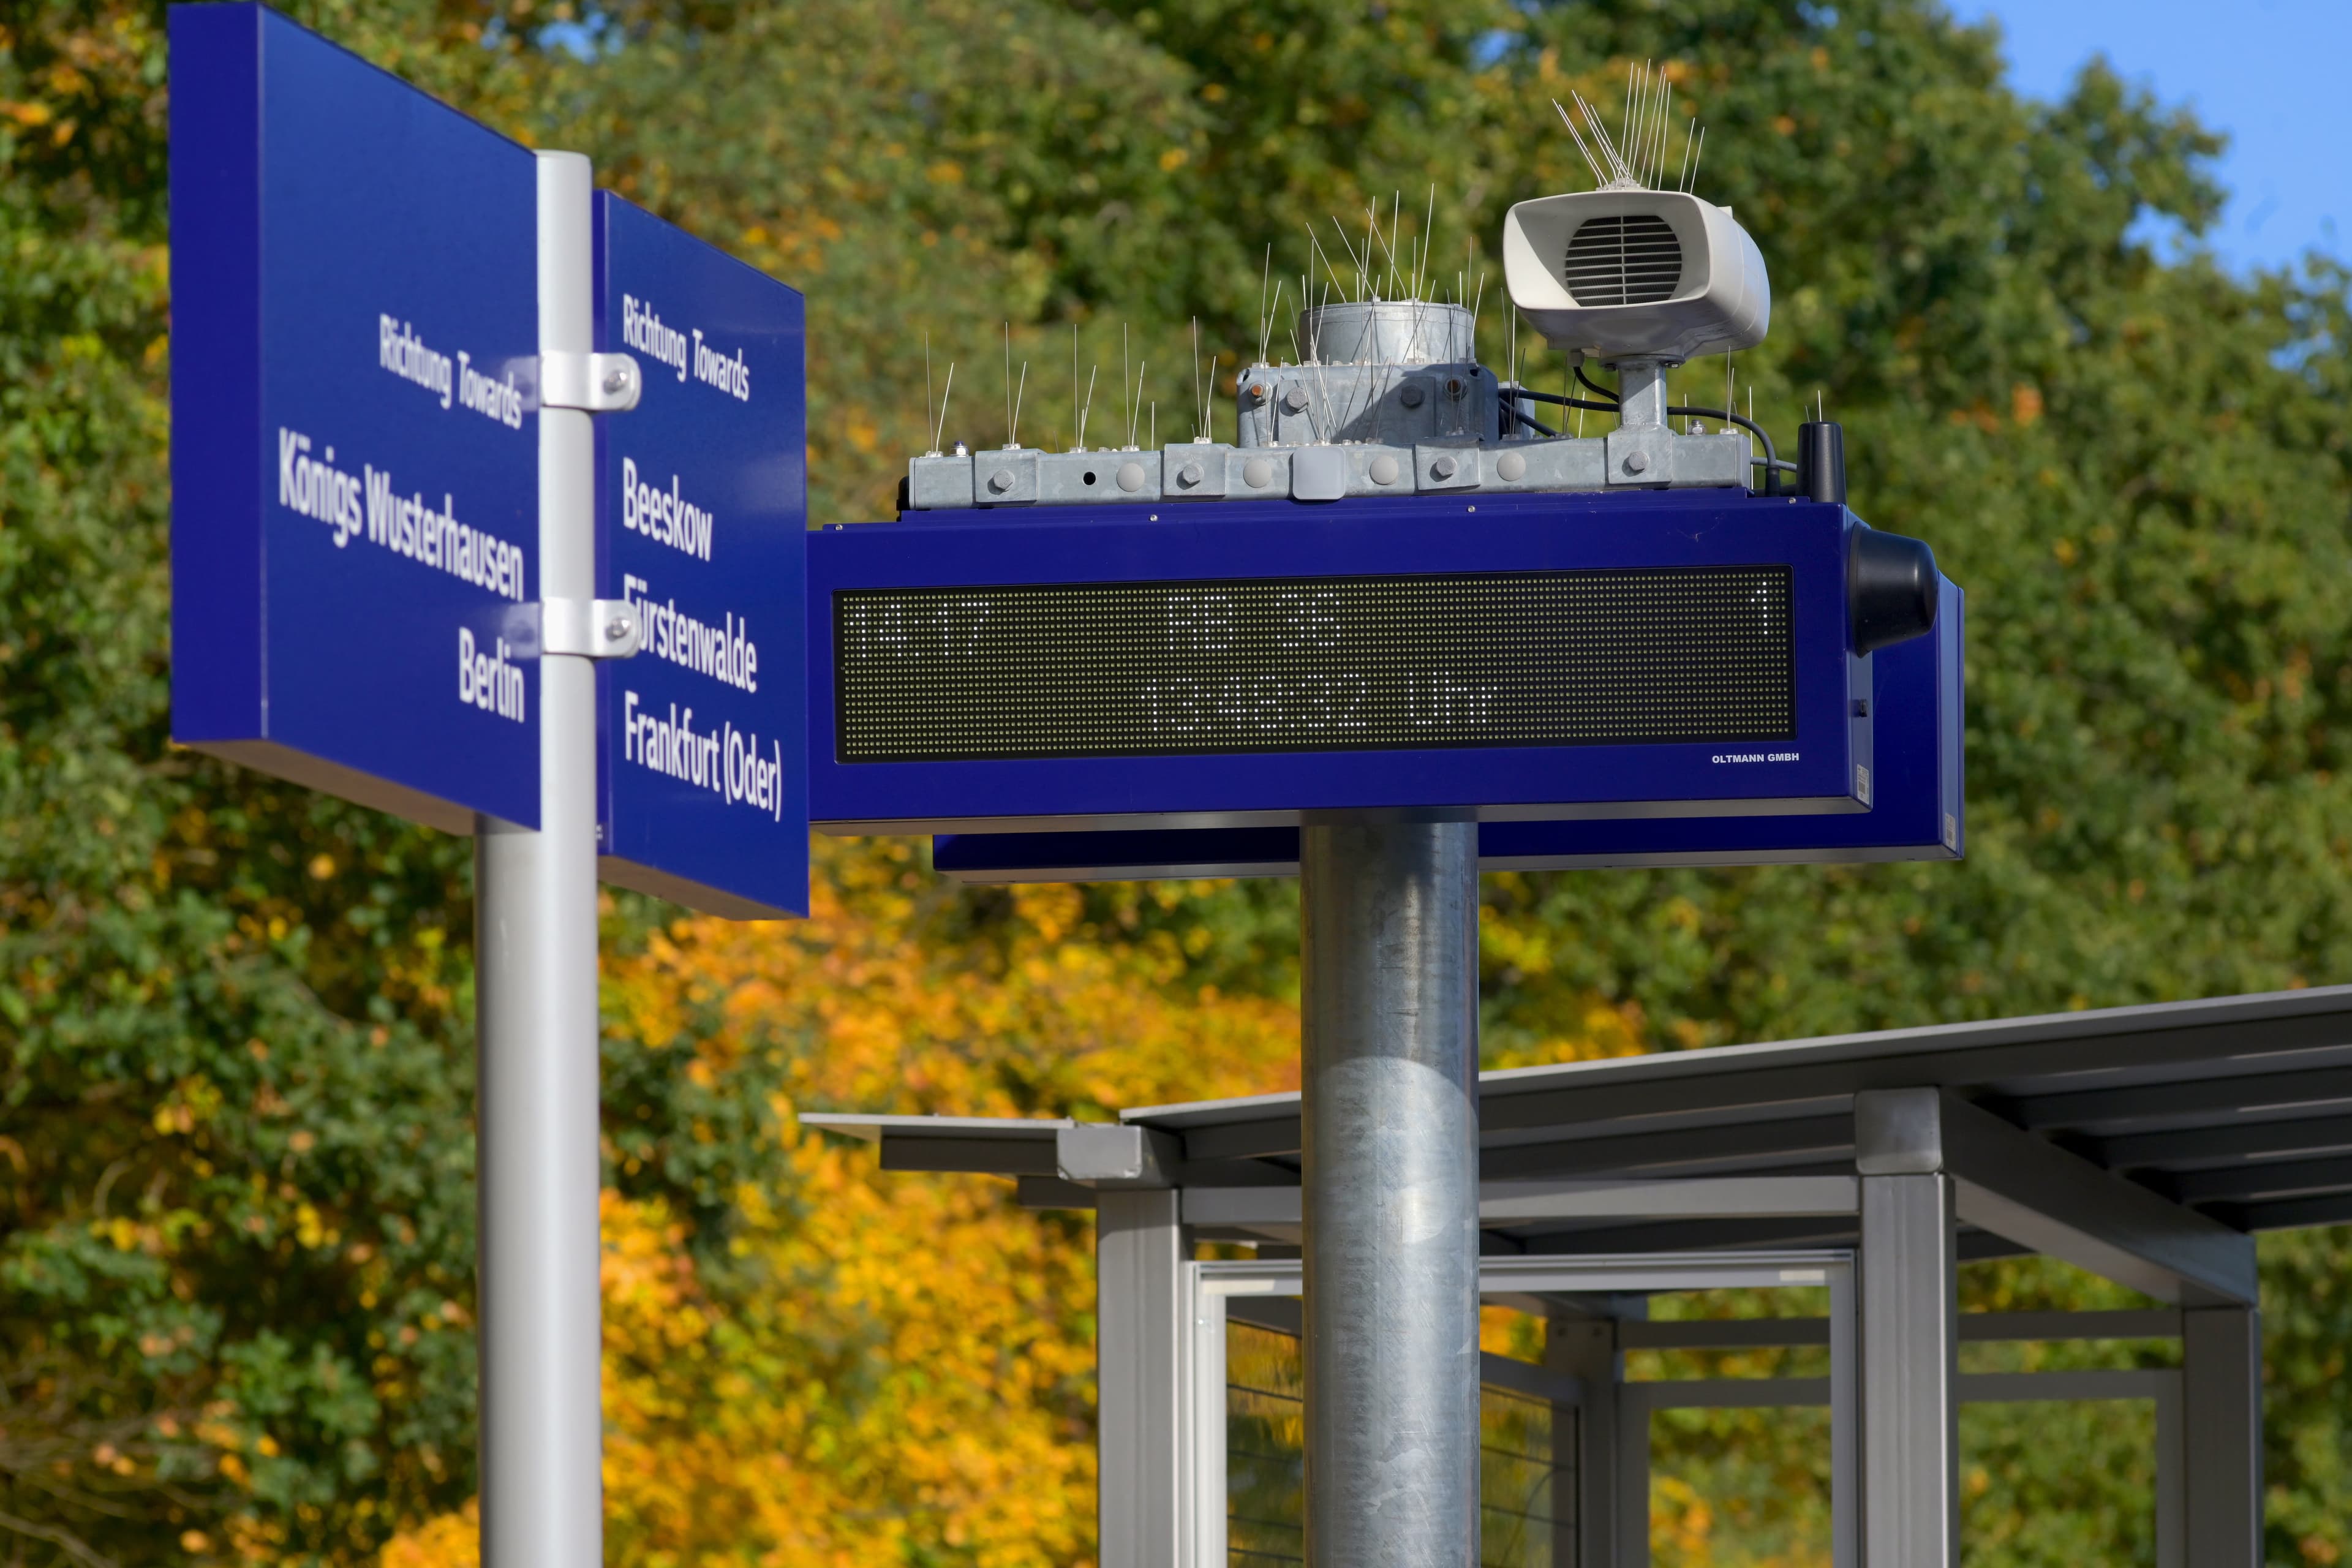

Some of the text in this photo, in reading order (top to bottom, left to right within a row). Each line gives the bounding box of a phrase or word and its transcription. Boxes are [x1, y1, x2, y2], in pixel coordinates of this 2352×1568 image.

[380, 313, 521, 429] Richtung Towards
[624, 293, 749, 402] Richtung Towards
[279, 428, 524, 601] Königs Wusterhausen
[623, 458, 712, 562] Beeskow
[850, 581, 1768, 658] 14:17 RB 36 1
[459, 628, 524, 722] Berlin
[1140, 671, 1497, 731] 13:48:32 Uhr
[625, 690, 781, 822] Frankfurt (Oder)
[1712, 753, 1800, 764] OLTMANN GMBH
